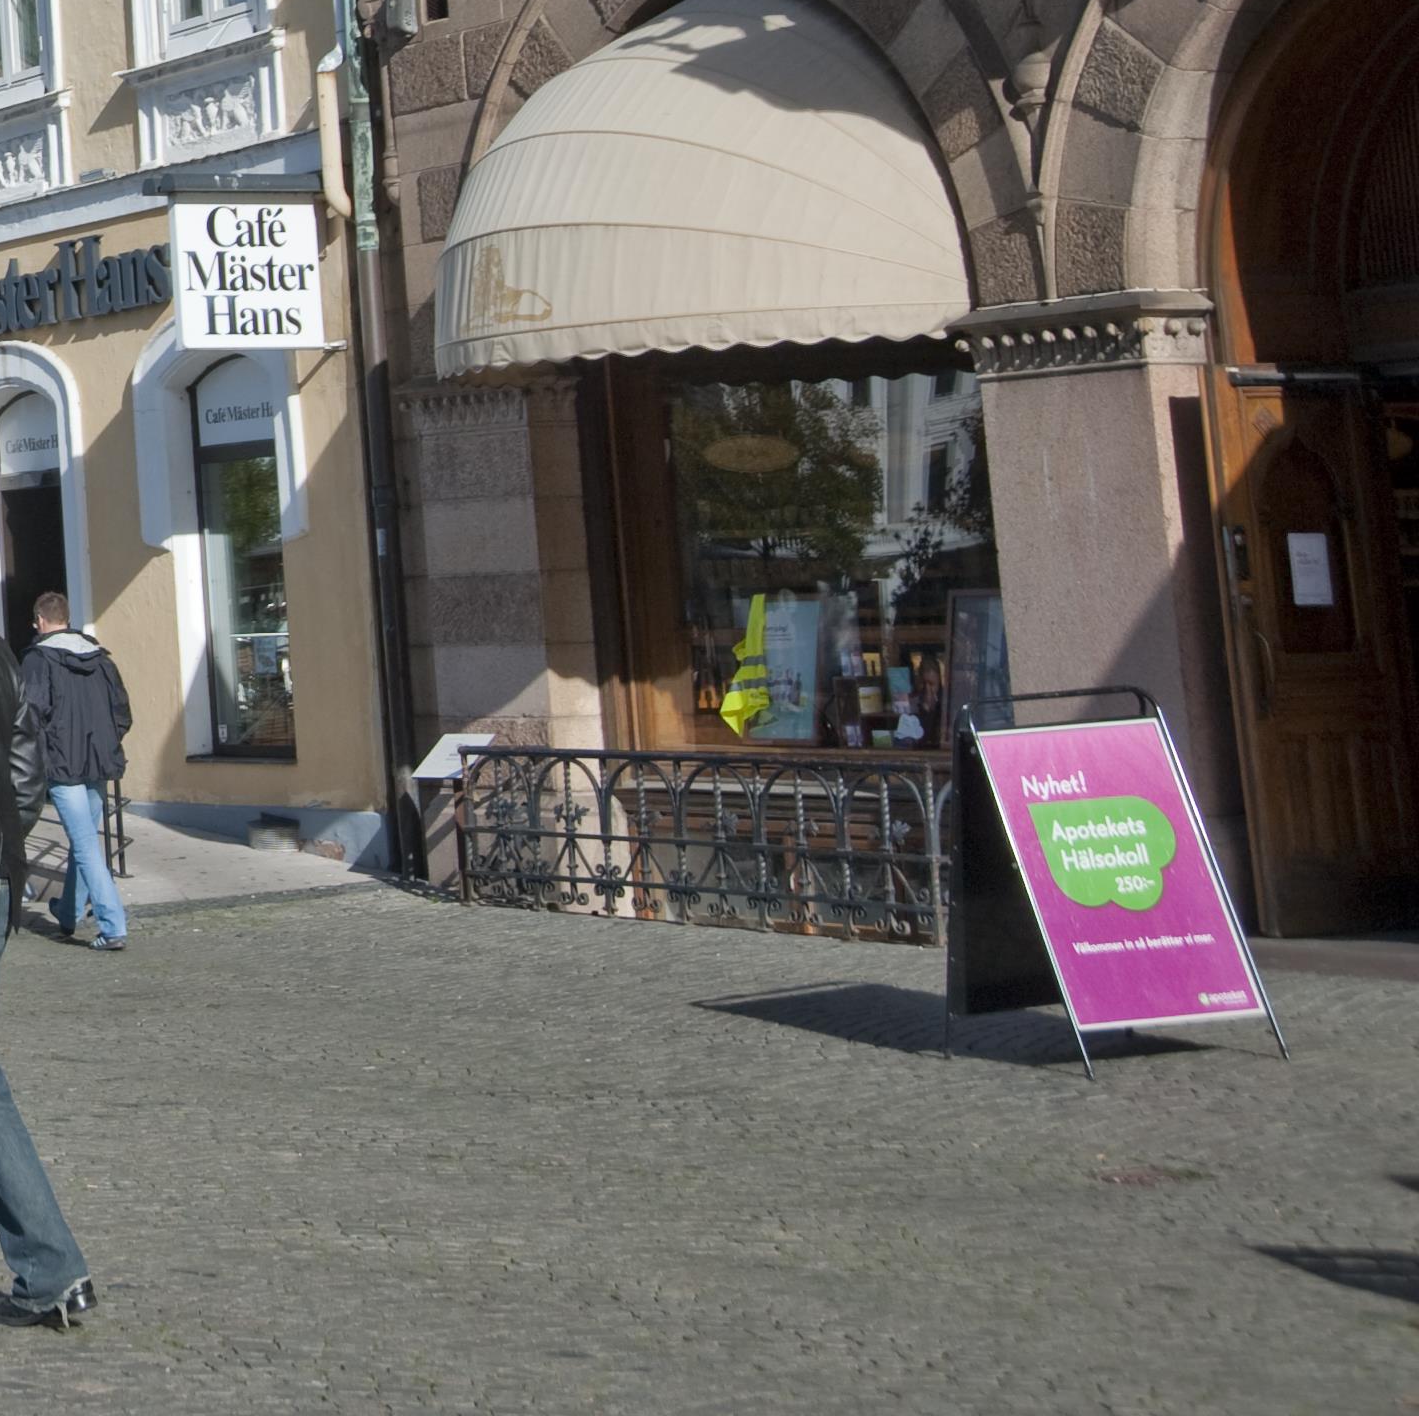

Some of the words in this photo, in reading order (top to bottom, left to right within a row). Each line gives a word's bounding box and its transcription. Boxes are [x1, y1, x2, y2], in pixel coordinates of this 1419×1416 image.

[207, 206, 288, 248] Café
[54, 234, 173, 320] Hans
[184, 250, 315, 292] Mäster
[203, 295, 303, 336] Hans
[1021, 770, 1088, 801] Nyhet!
[1052, 815, 1147, 846] Apotekets
[1061, 842, 1151, 872] Hälsokoll
